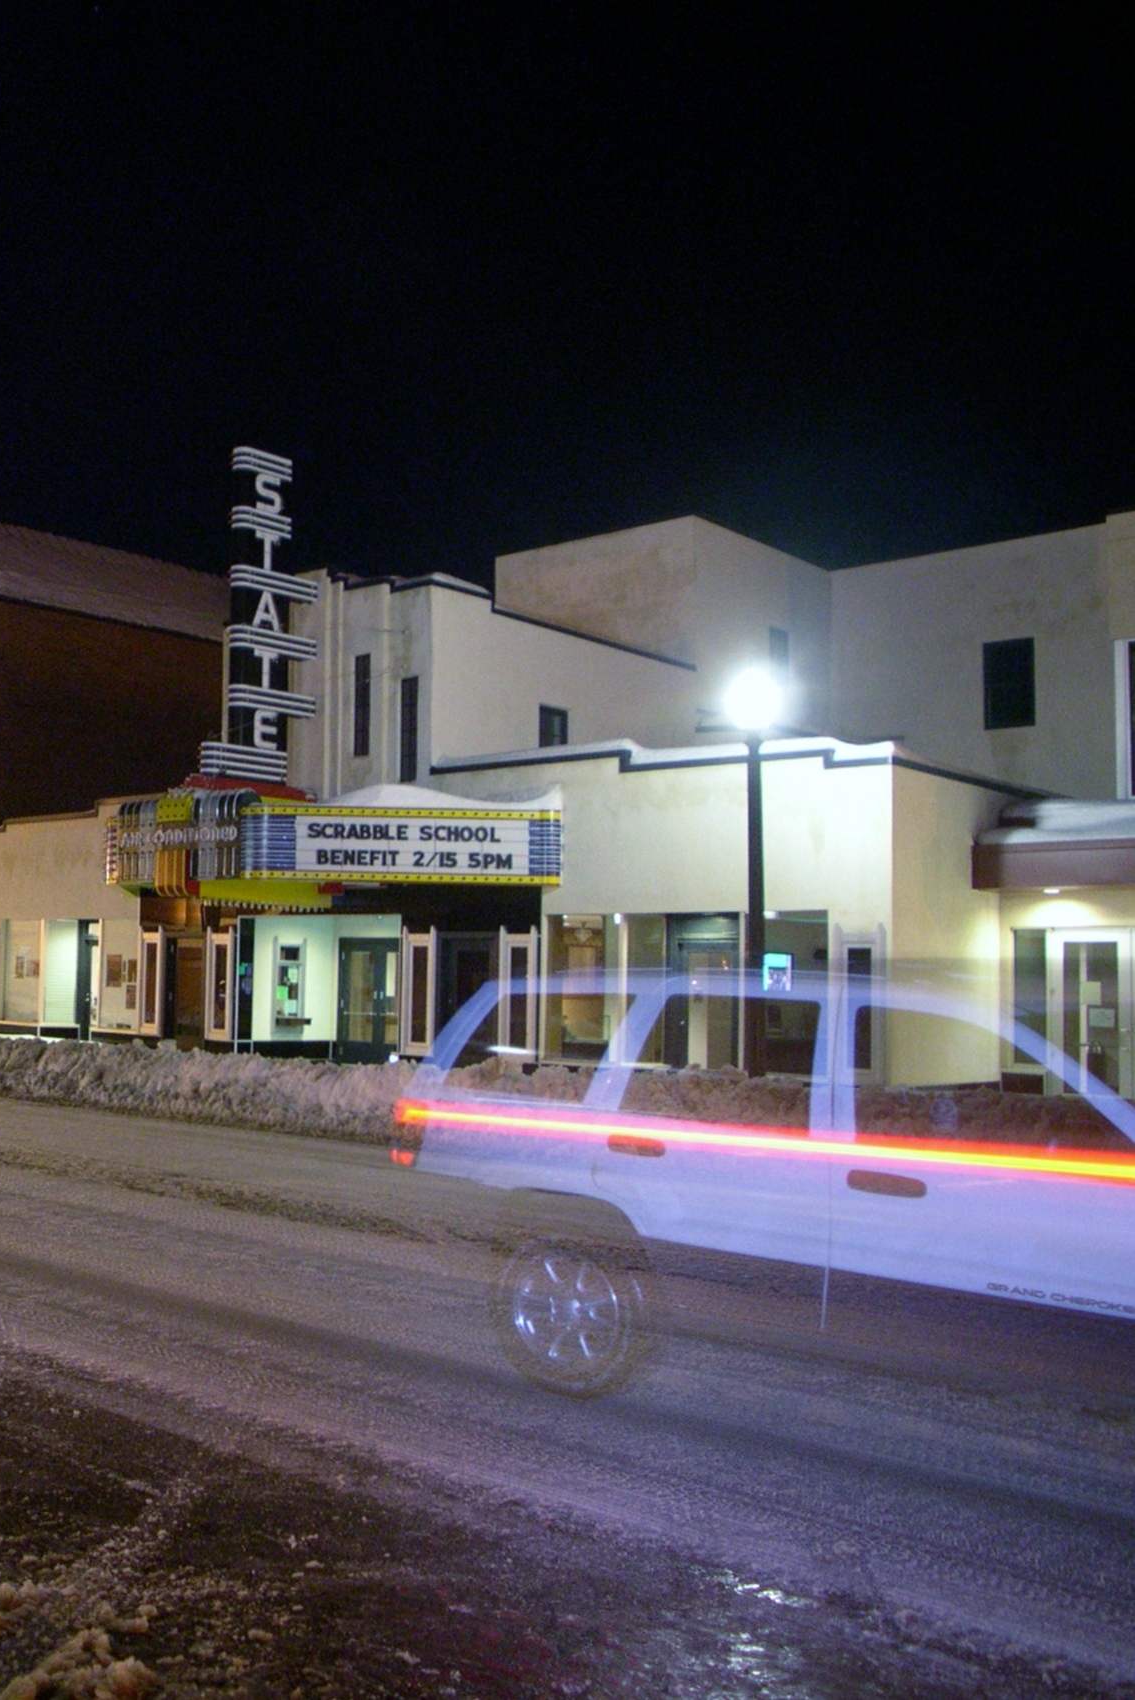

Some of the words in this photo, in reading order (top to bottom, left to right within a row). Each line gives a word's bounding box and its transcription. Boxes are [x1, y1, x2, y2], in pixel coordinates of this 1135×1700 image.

[252, 473, 283, 750] STATE
[307, 822, 409, 841] SCRABBLE
[419, 825, 501, 843] SCHOOL
[316, 849, 399, 867] BENEFIT
[412, 851, 458, 868] 2/15
[467, 852, 513, 870] 5PM
[986, 1281, 1046, 1299] GRAND
